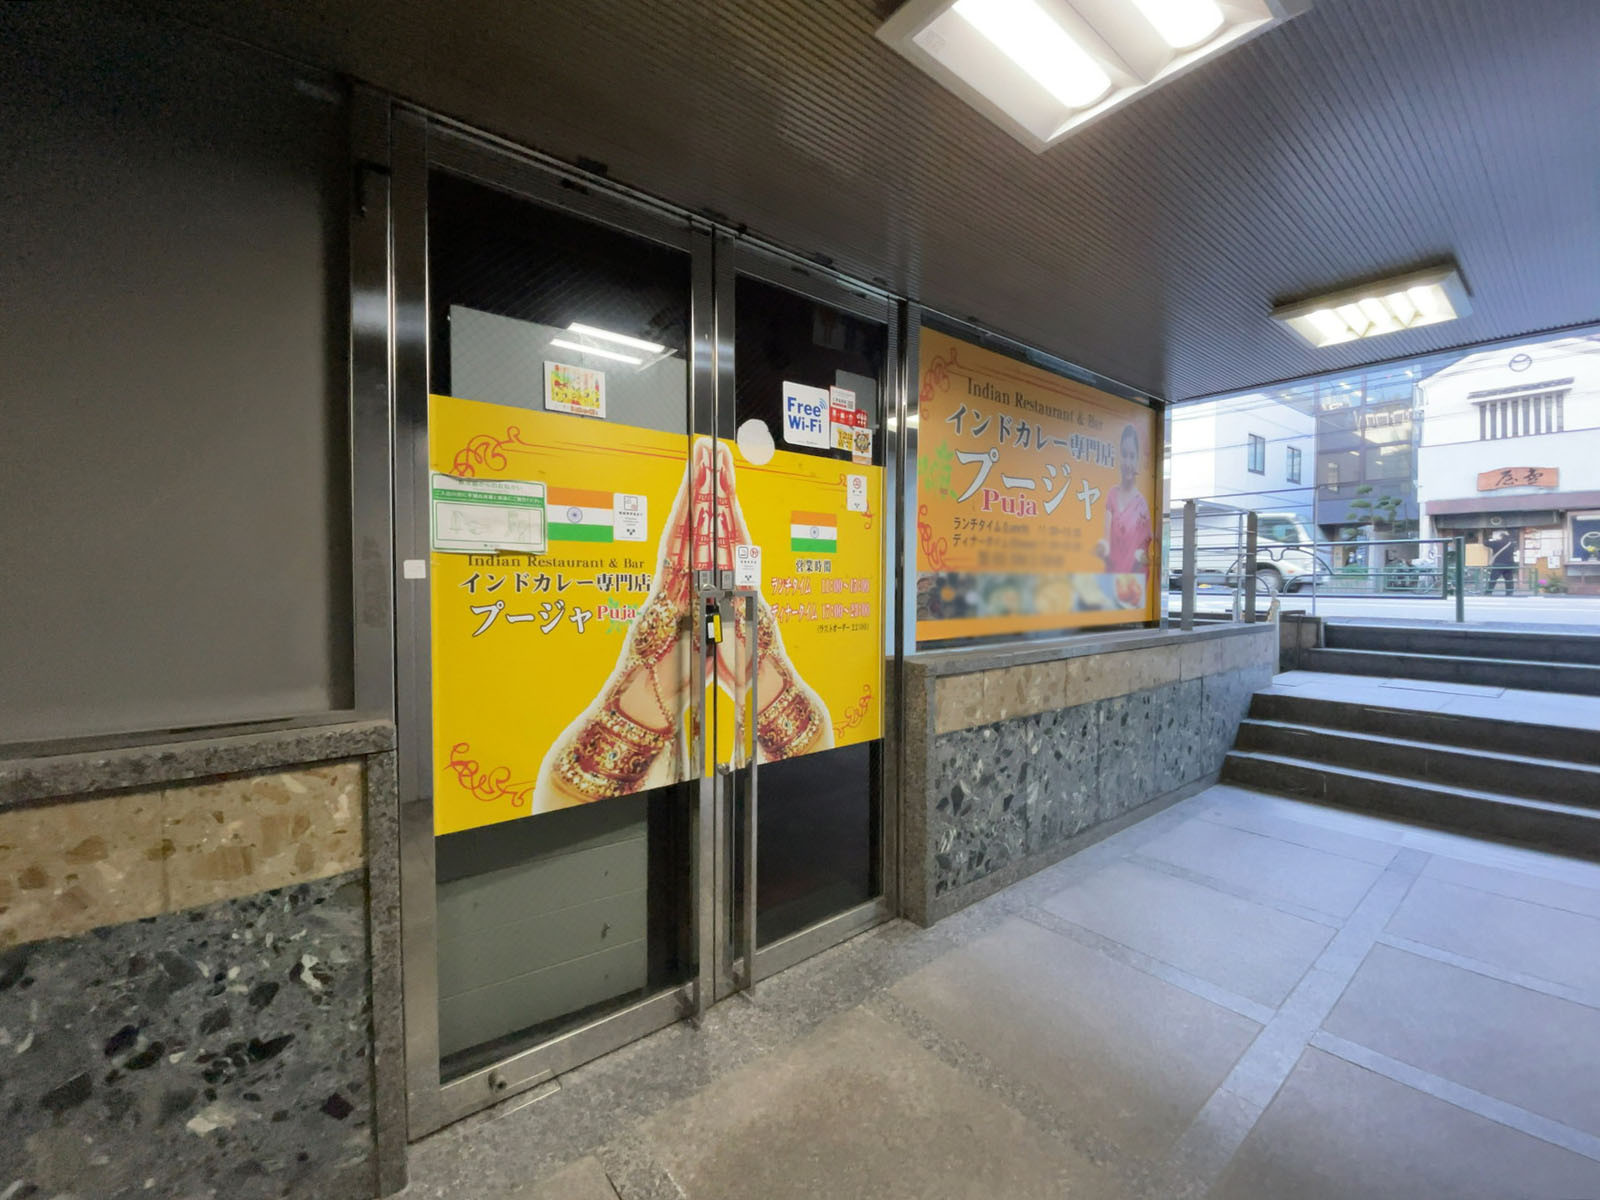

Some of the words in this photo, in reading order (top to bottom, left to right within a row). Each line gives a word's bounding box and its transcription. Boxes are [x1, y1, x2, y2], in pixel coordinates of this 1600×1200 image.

[787, 397, 822, 417] Free
[967, 377, 1010, 405] Indian
[1015, 391, 1075, 424] Restaurant
[788, 415, 822, 433] Wi-Fi
[946, 403, 1115, 469] インドカレー専門店
[955, 447, 1102, 521] プージャ
[981, 488, 1037, 517] Puja
[467, 555, 521, 567] Indian
[527, 556, 604, 568] Restaurant
[608, 558, 618, 568] &
[624, 558, 645, 569] Bar
[458, 573, 652, 593] インドカレー専門店
[470, 600, 593, 637] プージャ
[596, 605, 636, 623] Puja
